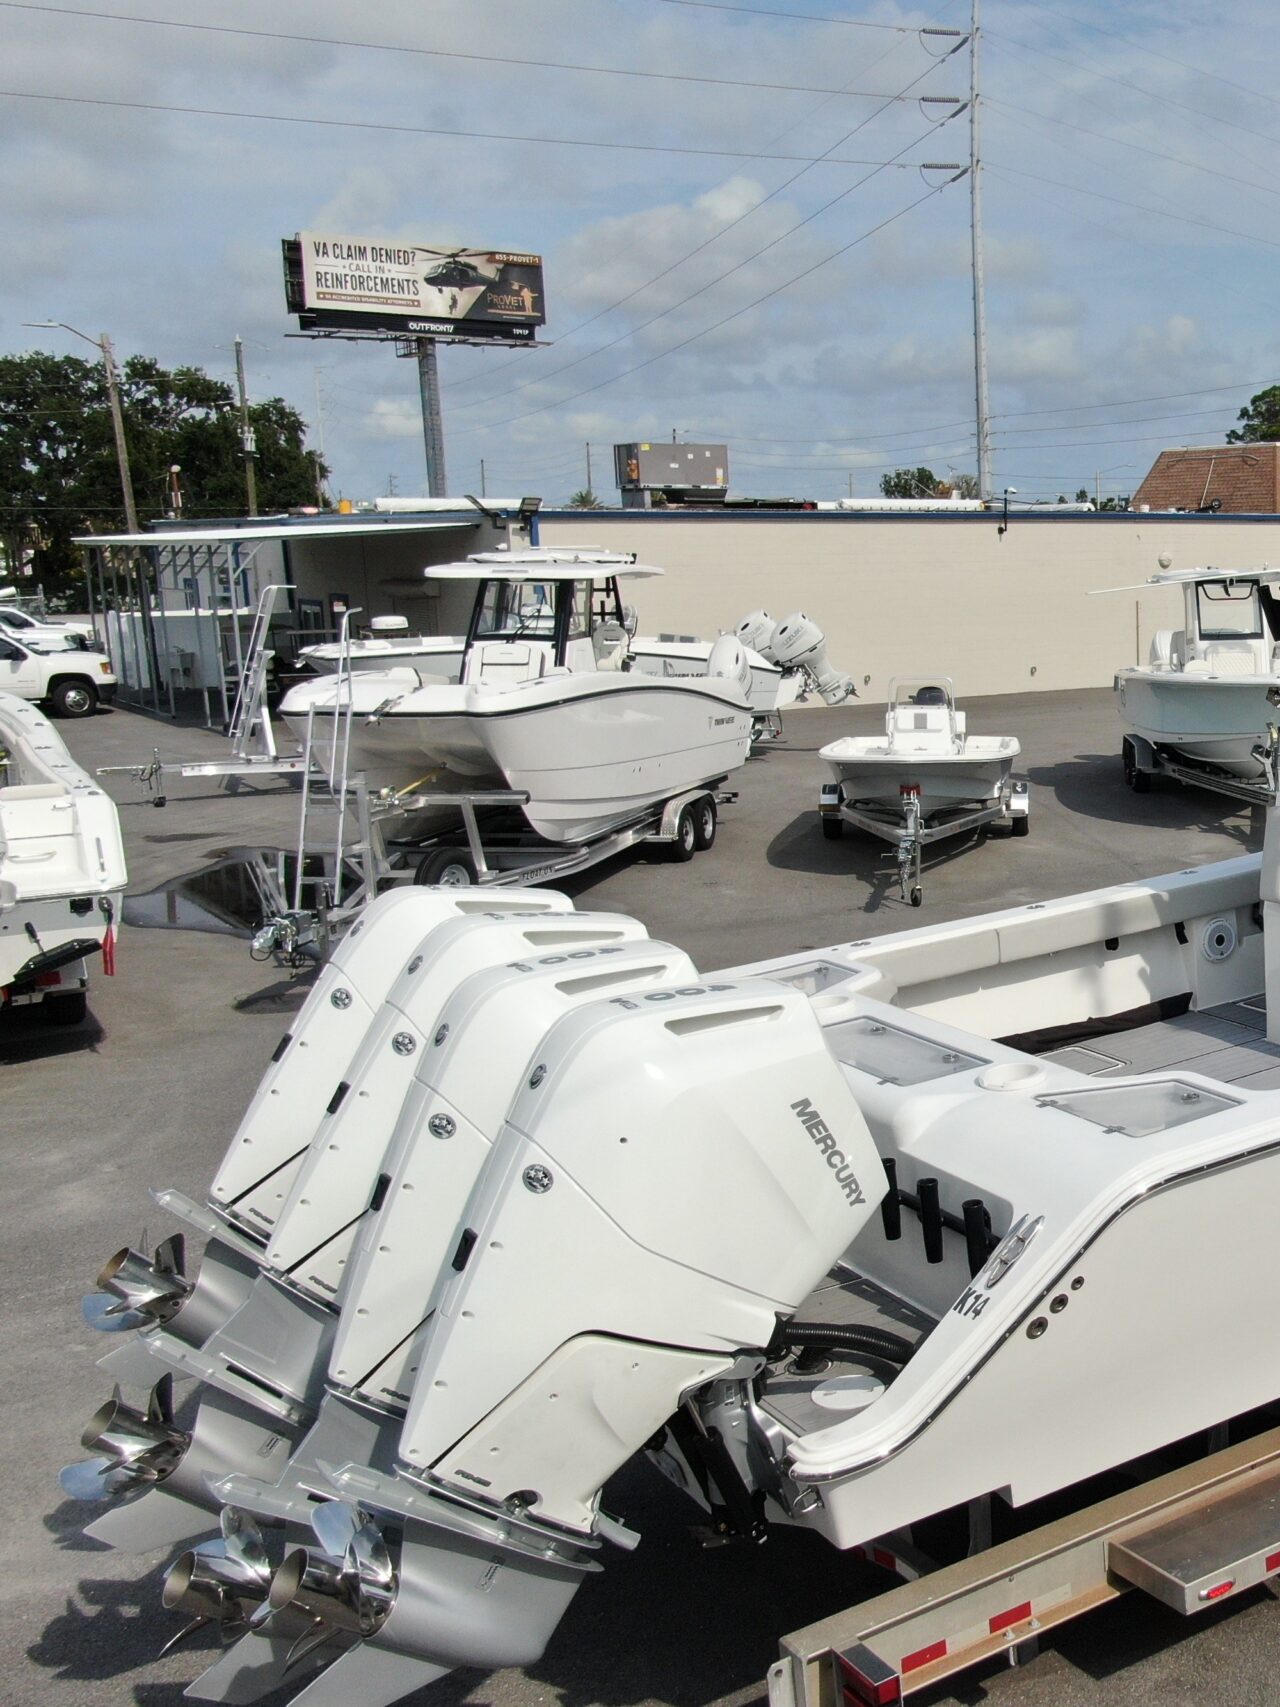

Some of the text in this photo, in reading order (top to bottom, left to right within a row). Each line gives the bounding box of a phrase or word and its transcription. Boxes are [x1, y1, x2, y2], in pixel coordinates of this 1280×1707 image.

[313, 241, 416, 267] VA CLAIM DENIED?
[348, 263, 385, 274] CALL IN
[315, 271, 419, 296] REINFORCEMENTS
[789, 1097, 867, 1208] MERCURY
[952, 1286, 991, 1321] K14
